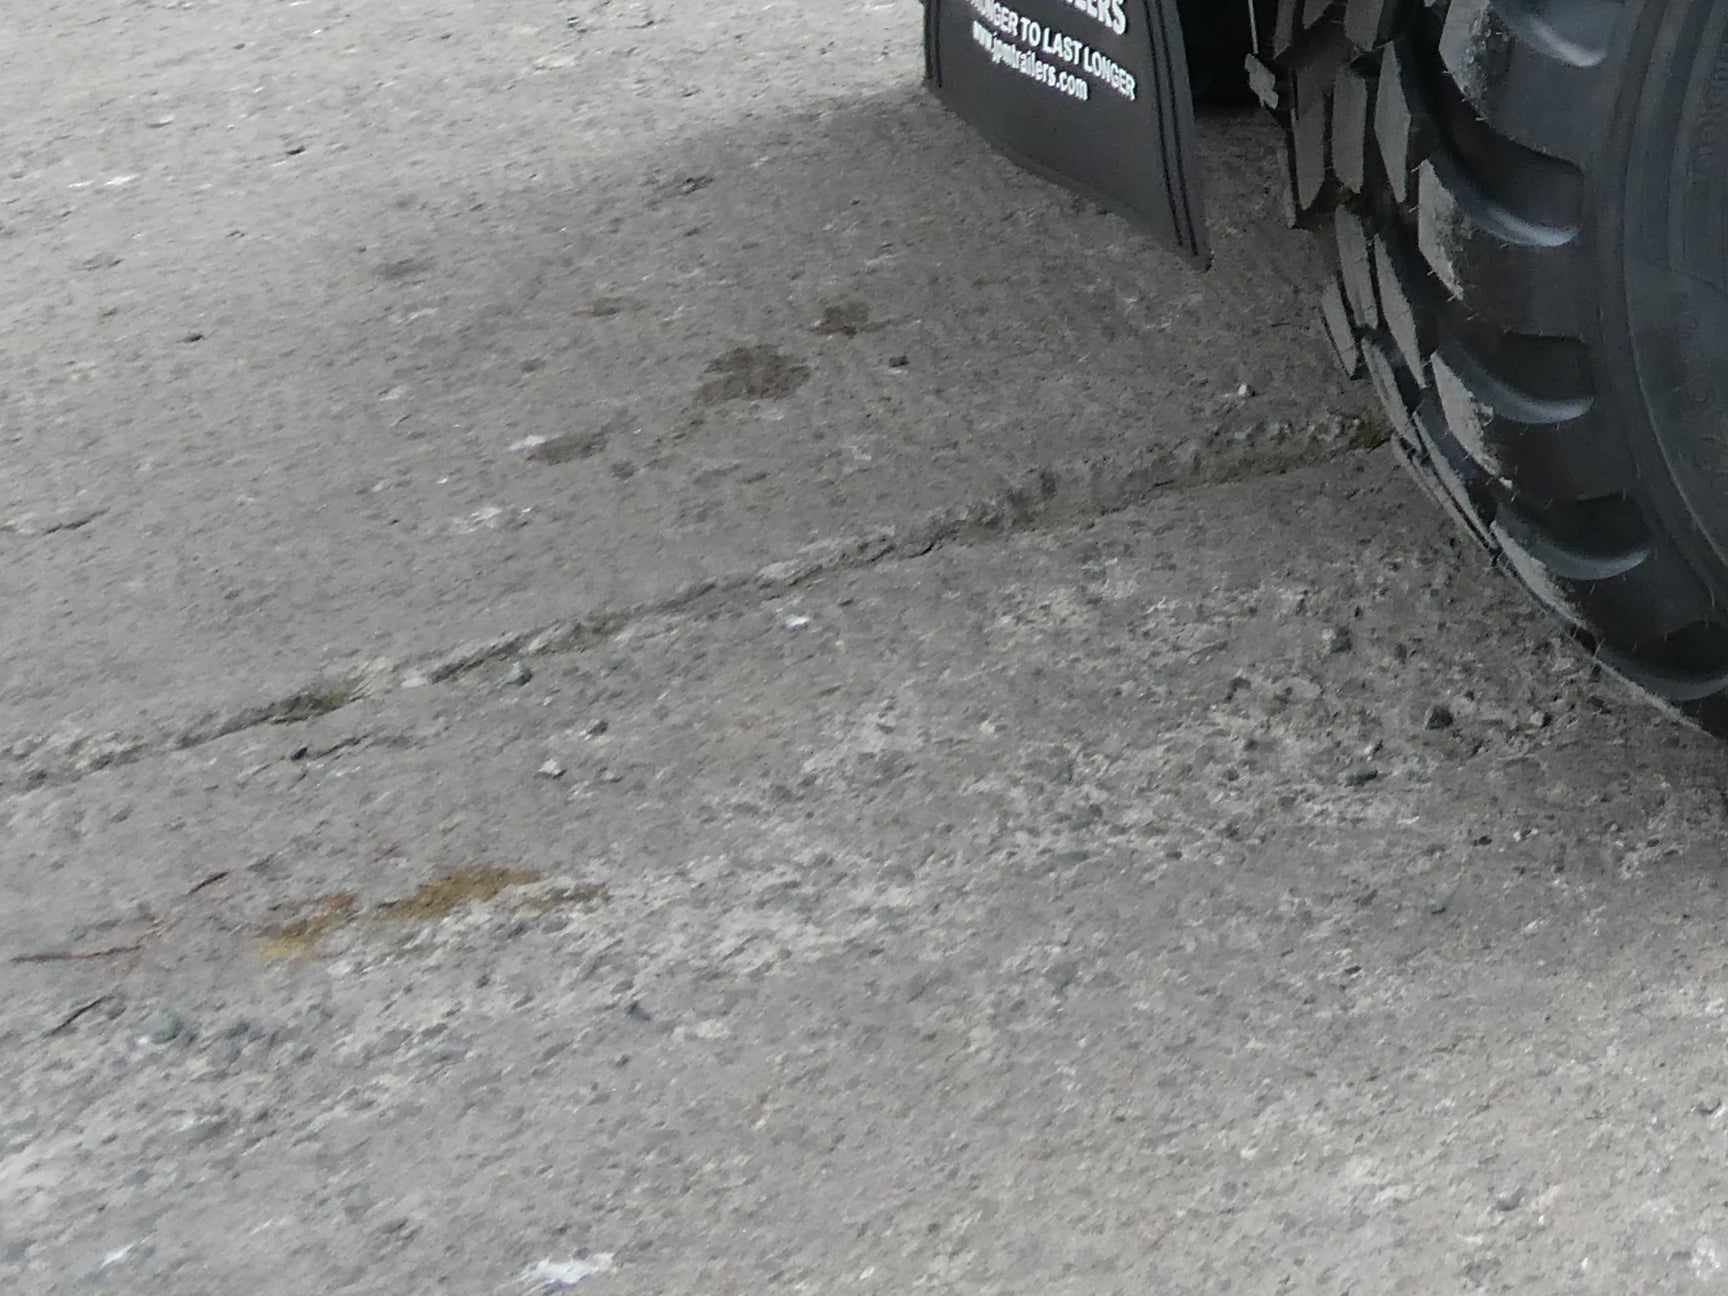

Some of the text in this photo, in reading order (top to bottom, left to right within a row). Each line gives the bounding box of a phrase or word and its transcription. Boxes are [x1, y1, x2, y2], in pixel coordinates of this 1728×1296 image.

[1020, 16, 1041, 47] TO
[1042, 27, 1083, 65] LAST
[1083, 46, 1136, 100] LONGER
